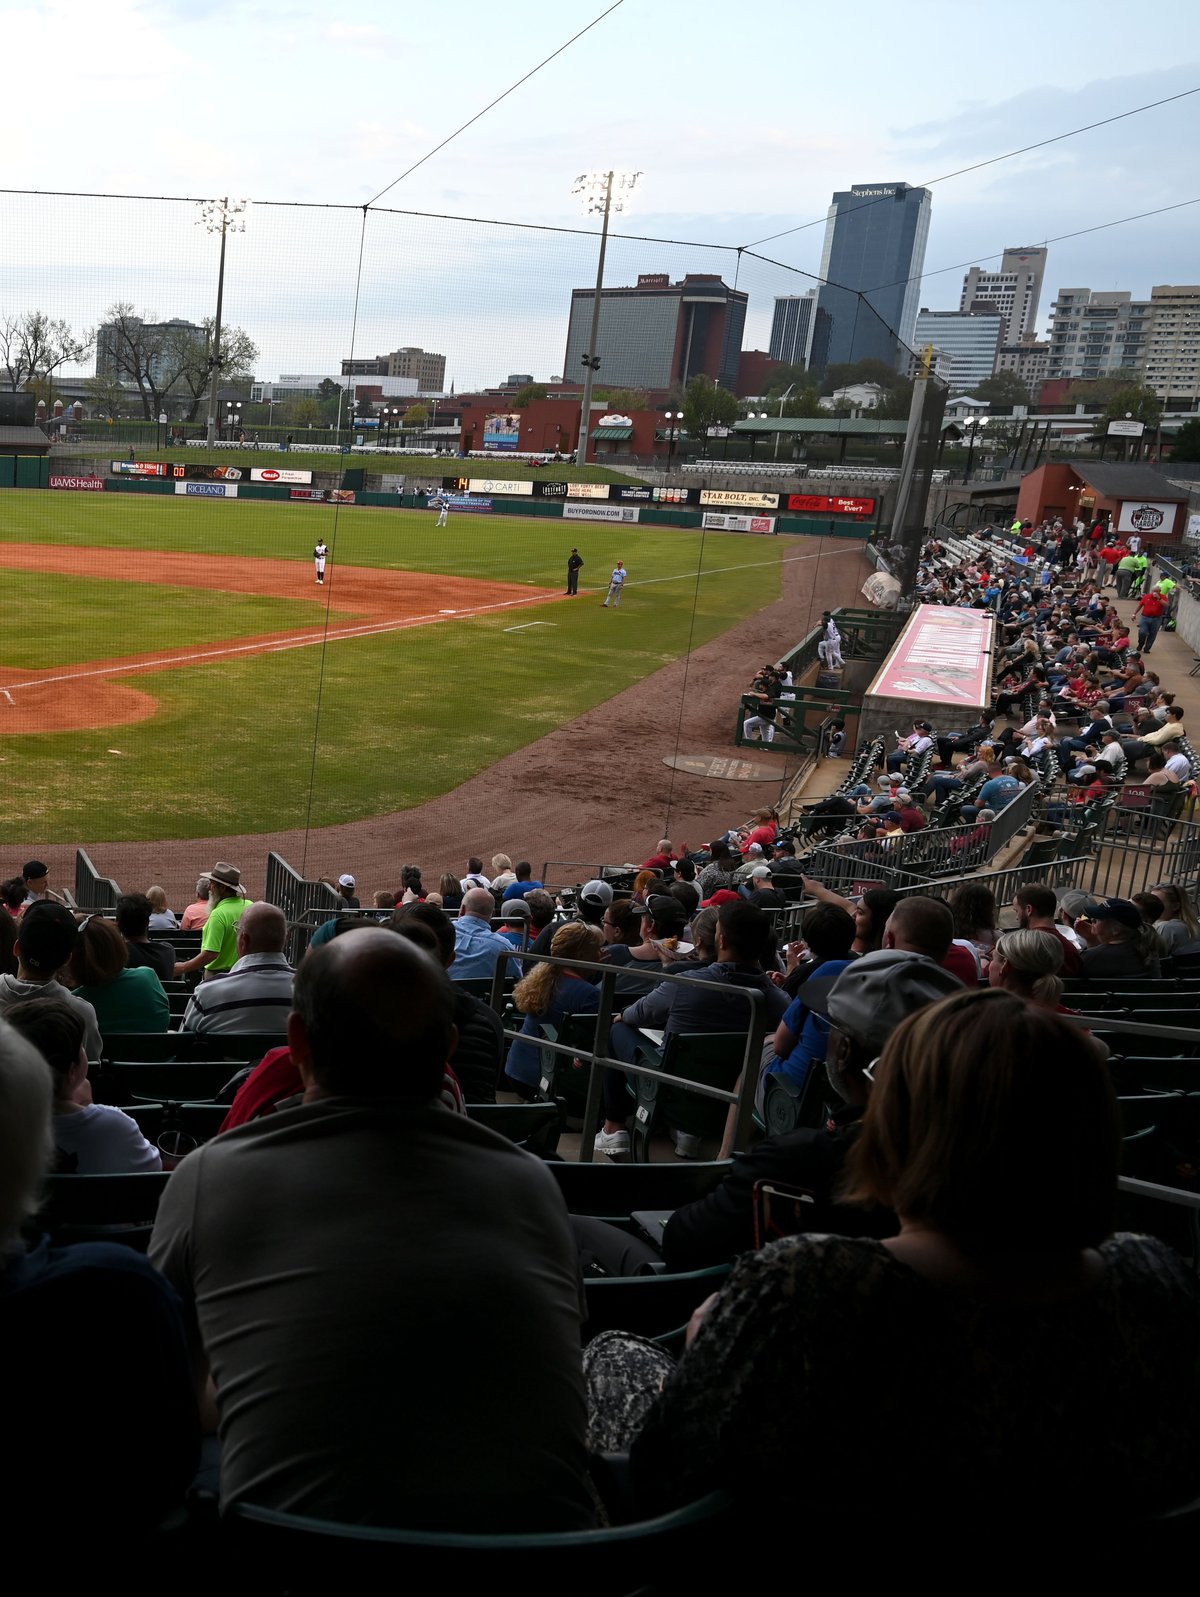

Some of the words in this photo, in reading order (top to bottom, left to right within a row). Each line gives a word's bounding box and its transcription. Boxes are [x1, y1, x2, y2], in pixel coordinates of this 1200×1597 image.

[852, 188, 883, 198] Stephens
[883, 187, 896, 195] Inc.
[173, 467, 185, 477] 00
[50, 478, 76, 488] UAMS
[76, 479, 103, 489] Health
[495, 483, 520, 491] CARTI
[187, 484, 224, 495] RICELAND
[724, 493, 747, 501] BOLT,
[567, 508, 620, 517] BUYFORDNOW.COM
[1134, 520, 1160, 528] GARDEN
[640, 1109, 645, 1119] G
